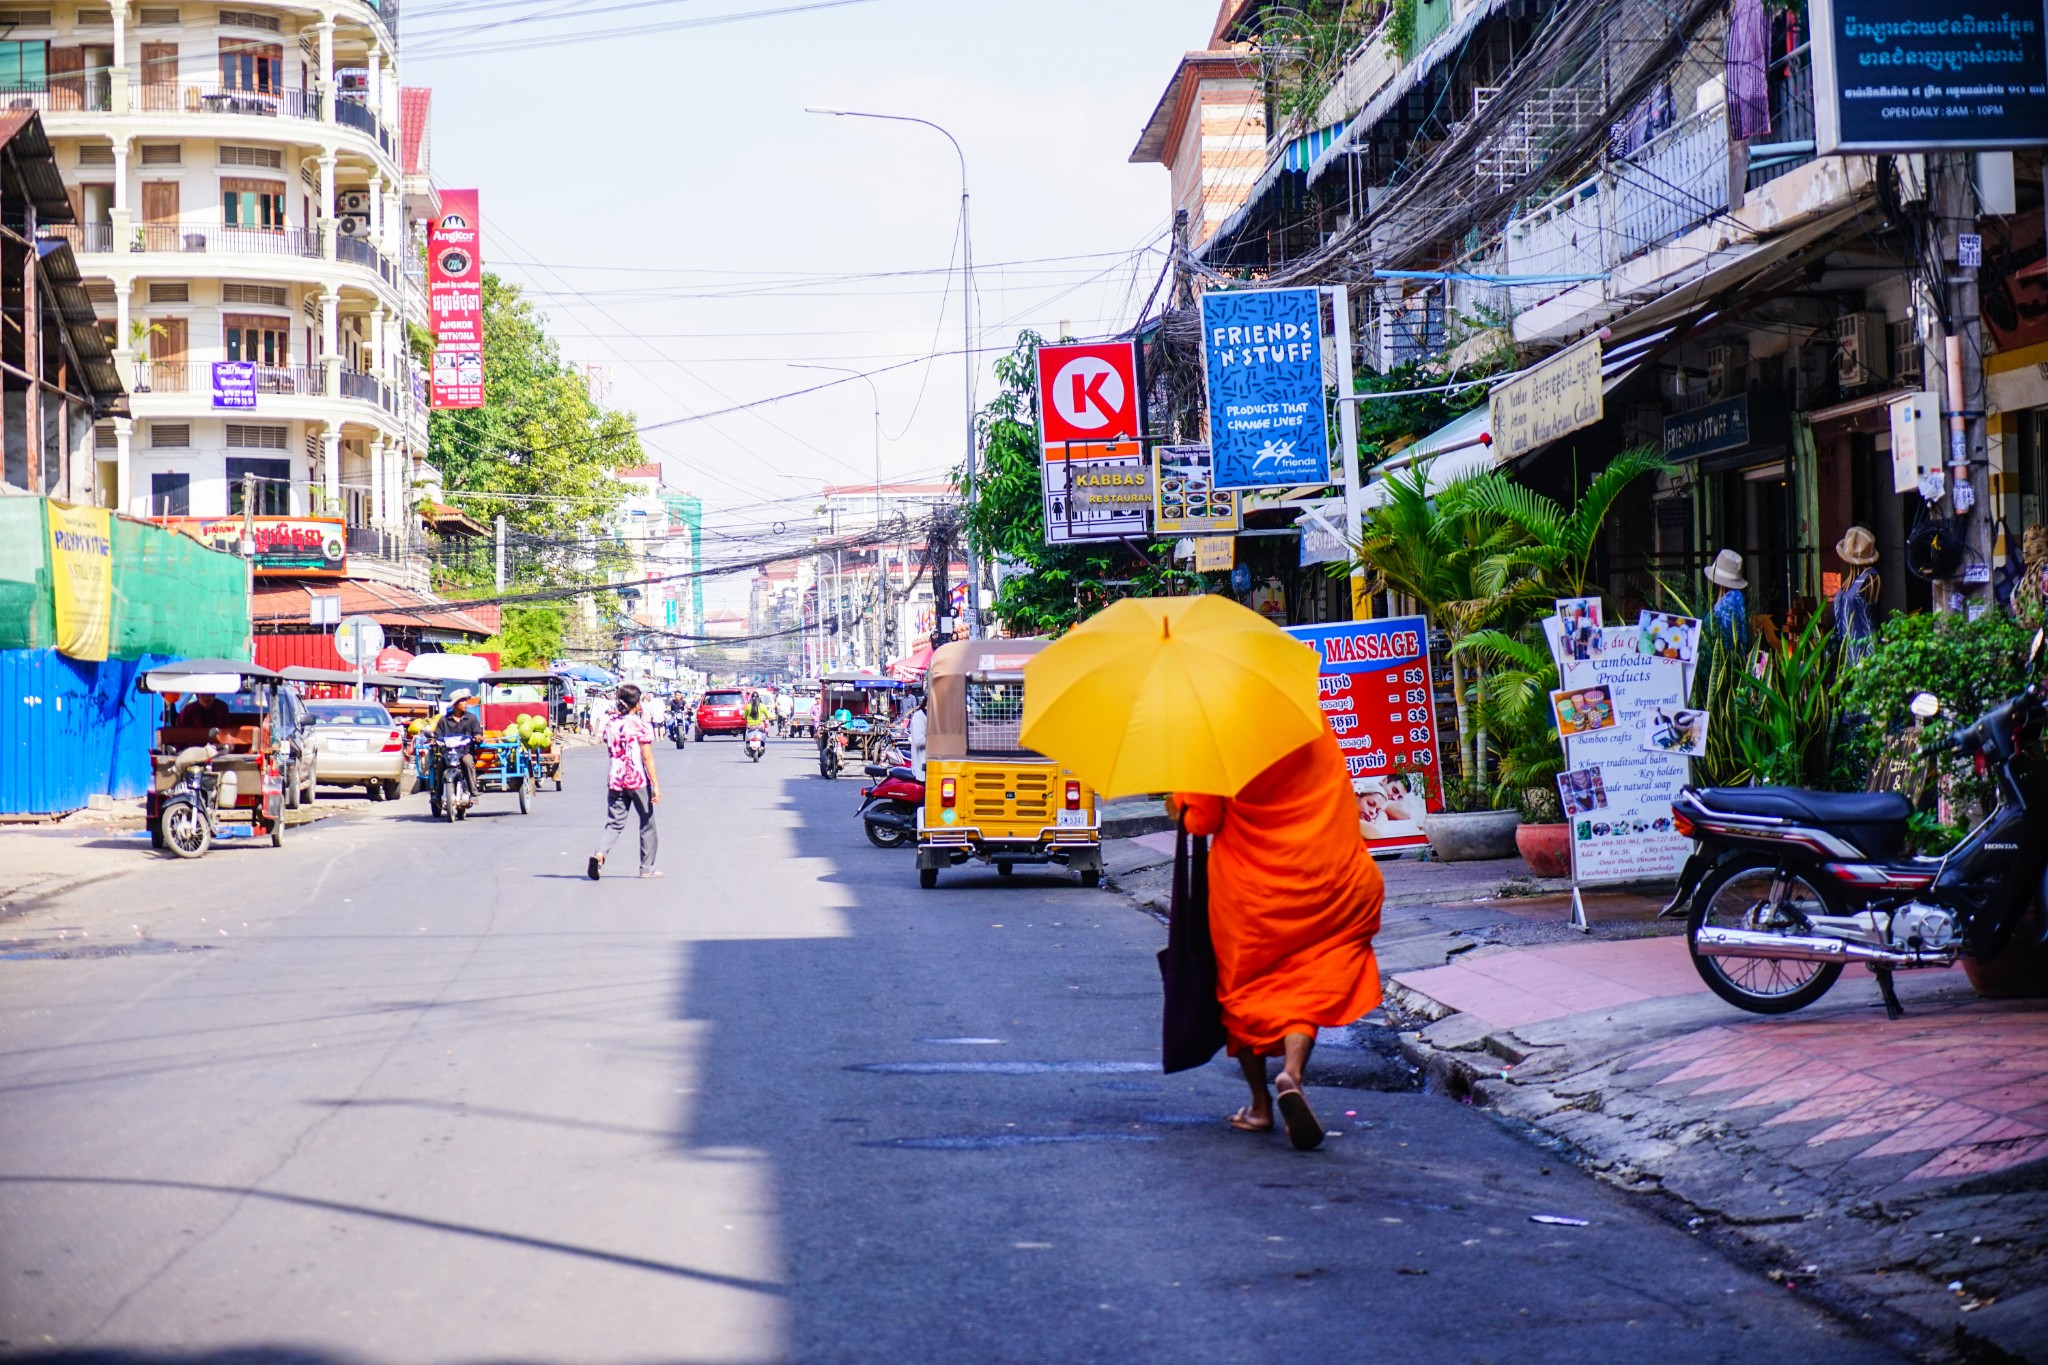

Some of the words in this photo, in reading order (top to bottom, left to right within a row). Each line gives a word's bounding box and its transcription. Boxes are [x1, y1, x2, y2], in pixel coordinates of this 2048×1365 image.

[1881, 107, 1909, 118] OPEN
[1911, 106, 1939, 117] DAILY
[1946, 105, 1968, 116] 8AM
[1977, 105, 2003, 116] 10PM
[440, 321, 473, 329] ANGKOR
[1213, 321, 1312, 346] FRIENDS
[1227, 403, 1278, 417] PRODUCTS
[1282, 403, 1308, 414] THAT
[1228, 418, 1270, 430] CHANGE
[1273, 415, 1303, 427] LIVES
[1668, 421, 1695, 449] FRIENDS
[1282, 457, 1316, 467] friends
[1076, 473, 1145, 487] KABBAS
[1089, 493, 1152, 504] RESTAURAN
[1326, 632, 1418, 663] MASSAGE
[1592, 654, 1652, 670] Cambodia
[1404, 669, 1423, 683] 5$
[1596, 669, 1651, 685] Products
[1319, 697, 1353, 710] assage)
[1407, 689, 1425, 703] 5$
[1635, 697, 1660, 709] Pepper
[1662, 693, 1679, 704] mill
[1408, 709, 1427, 722] 3$
[1337, 735, 1371, 748] assage)
[1411, 729, 1430, 742] 3$
[1577, 732, 1608, 744] Bamboo
[1610, 731, 1632, 745] crafts
[1607, 755, 1647, 767] traditional
[1649, 753, 1668, 765] balm
[1639, 768, 1654, 779] Key
[1657, 765, 1684, 776] holders
[1624, 778, 1652, 791] natural
[1654, 781, 1671, 791] soap
[1641, 793, 1671, 804] Coconut
